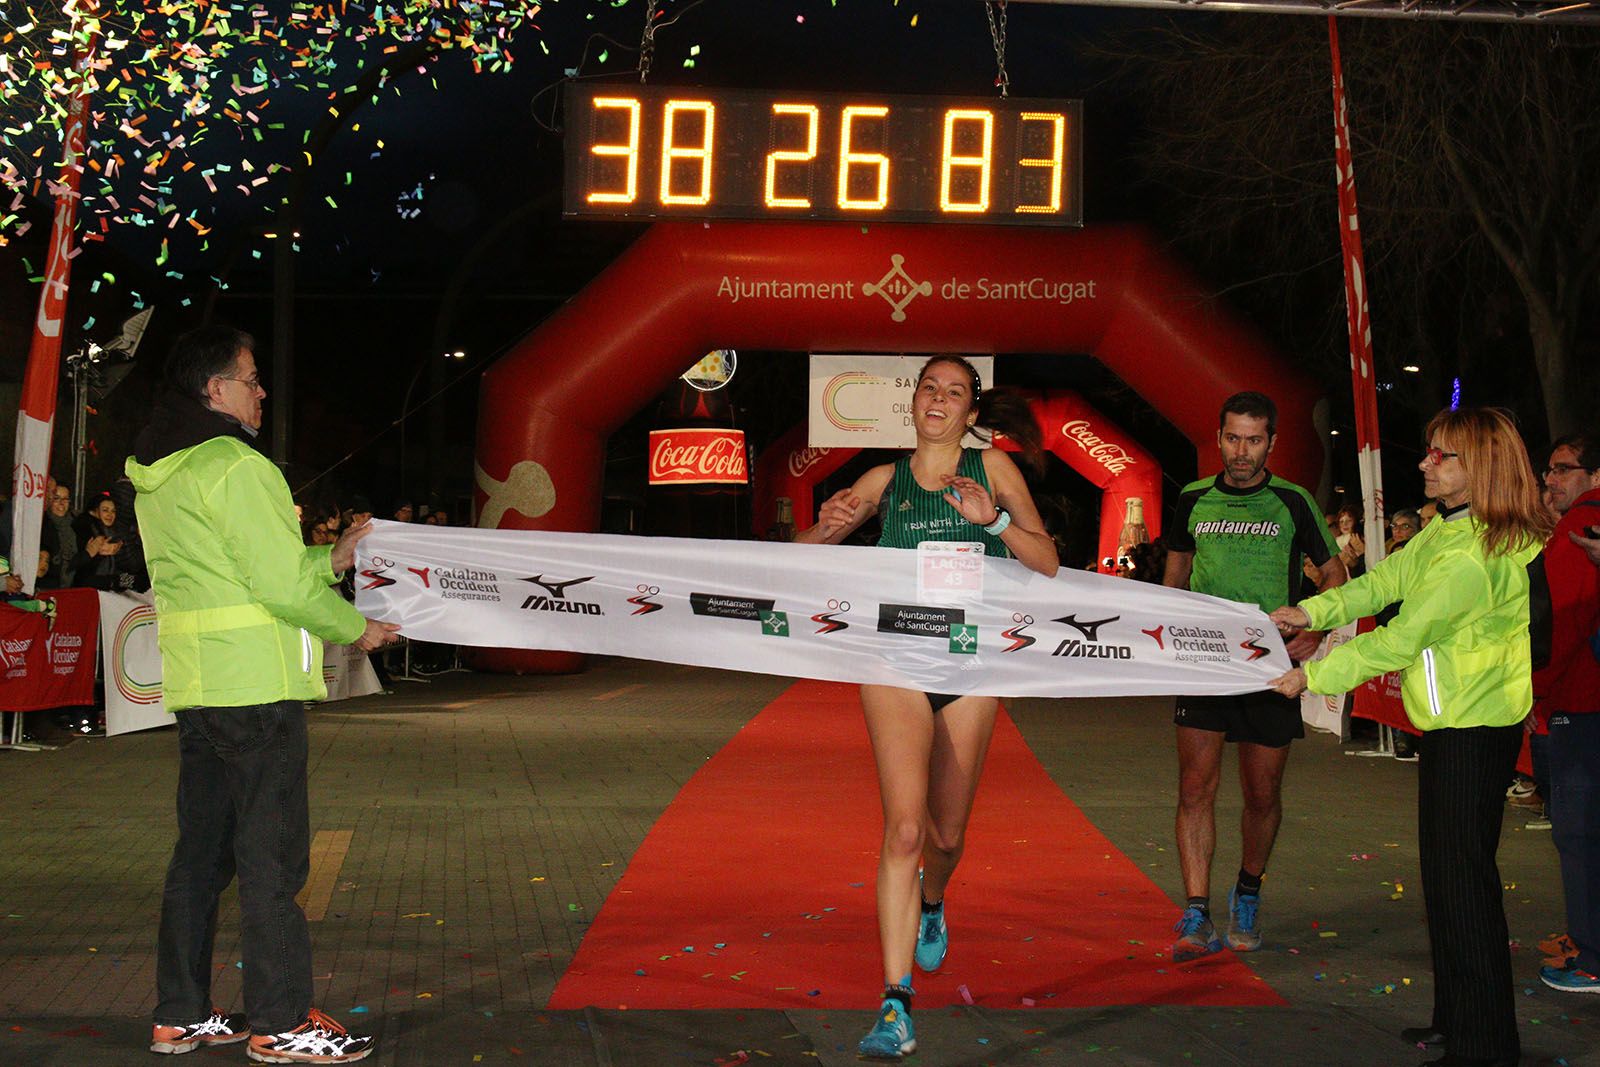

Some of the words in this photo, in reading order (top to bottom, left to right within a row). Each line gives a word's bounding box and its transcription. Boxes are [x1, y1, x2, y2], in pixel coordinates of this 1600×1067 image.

[587, 97, 715, 205] 38
[765, 104, 889, 210] 26
[940, 109, 1065, 214] 83
[716, 276, 854, 304] Ajuntament
[941, 277, 970, 300] de
[976, 278, 1096, 305] SantCugat
[1062, 420, 1137, 477] Coca-Cola
[652, 437, 745, 478] Coca-Cola
[910, 521, 927, 530] RUN
[929, 517, 952, 528] WITH
[434, 567, 497, 581] Catalana
[439, 577, 500, 593] Occident
[441, 591, 501, 601] Assegurances
[708, 598, 755, 609] Ajuntament
[898, 610, 946, 621] Ajuntament
[894, 620, 905, 628] de
[906, 621, 949, 633] SantCugat
[1168, 625, 1226, 639] Catalana
[1173, 639, 1230, 653] Occident
[1175, 652, 1231, 663] Assegurances
